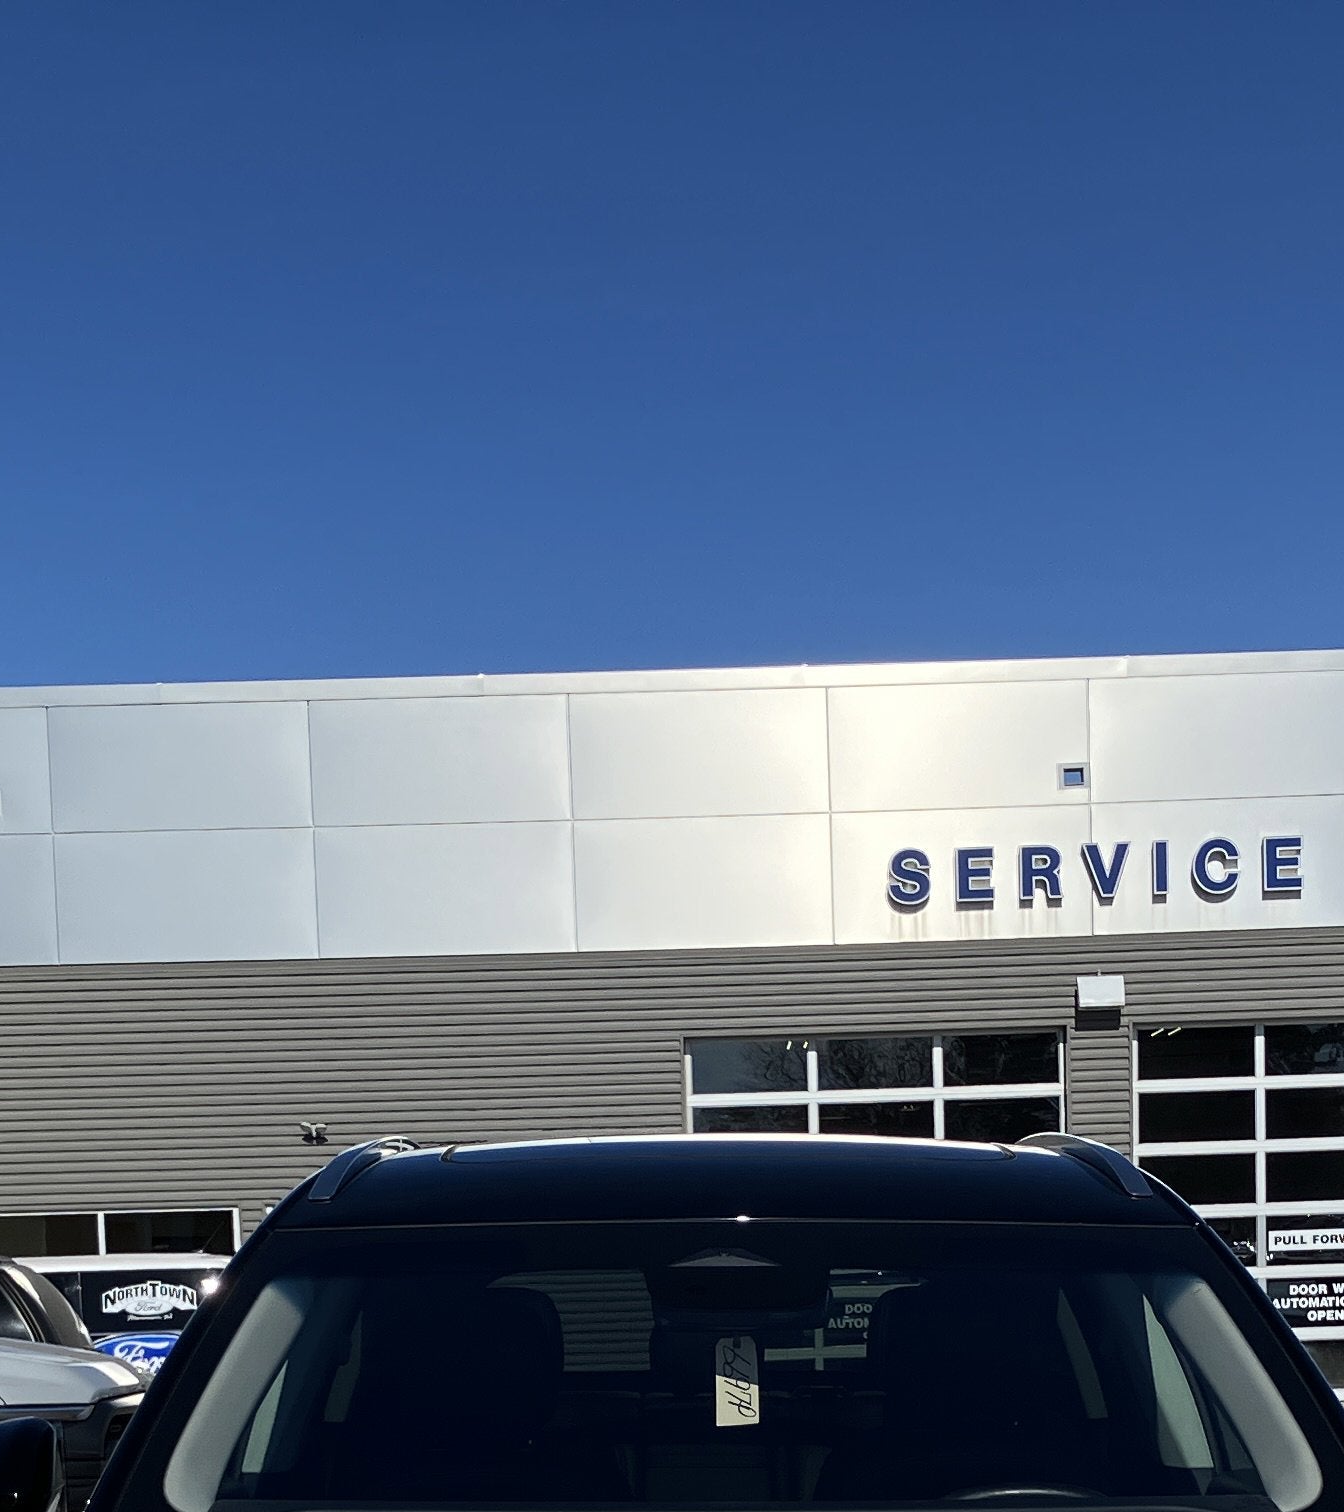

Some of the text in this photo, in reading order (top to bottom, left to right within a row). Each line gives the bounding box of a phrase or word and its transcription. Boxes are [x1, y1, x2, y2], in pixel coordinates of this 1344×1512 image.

[887, 835, 1304, 908] SERVICE
[1273, 1235, 1307, 1246] PULL
[1289, 1284, 1328, 1296] DOOR
[134, 1302, 163, 1312] Ford
[1307, 1309, 1344, 1322] OPEN
